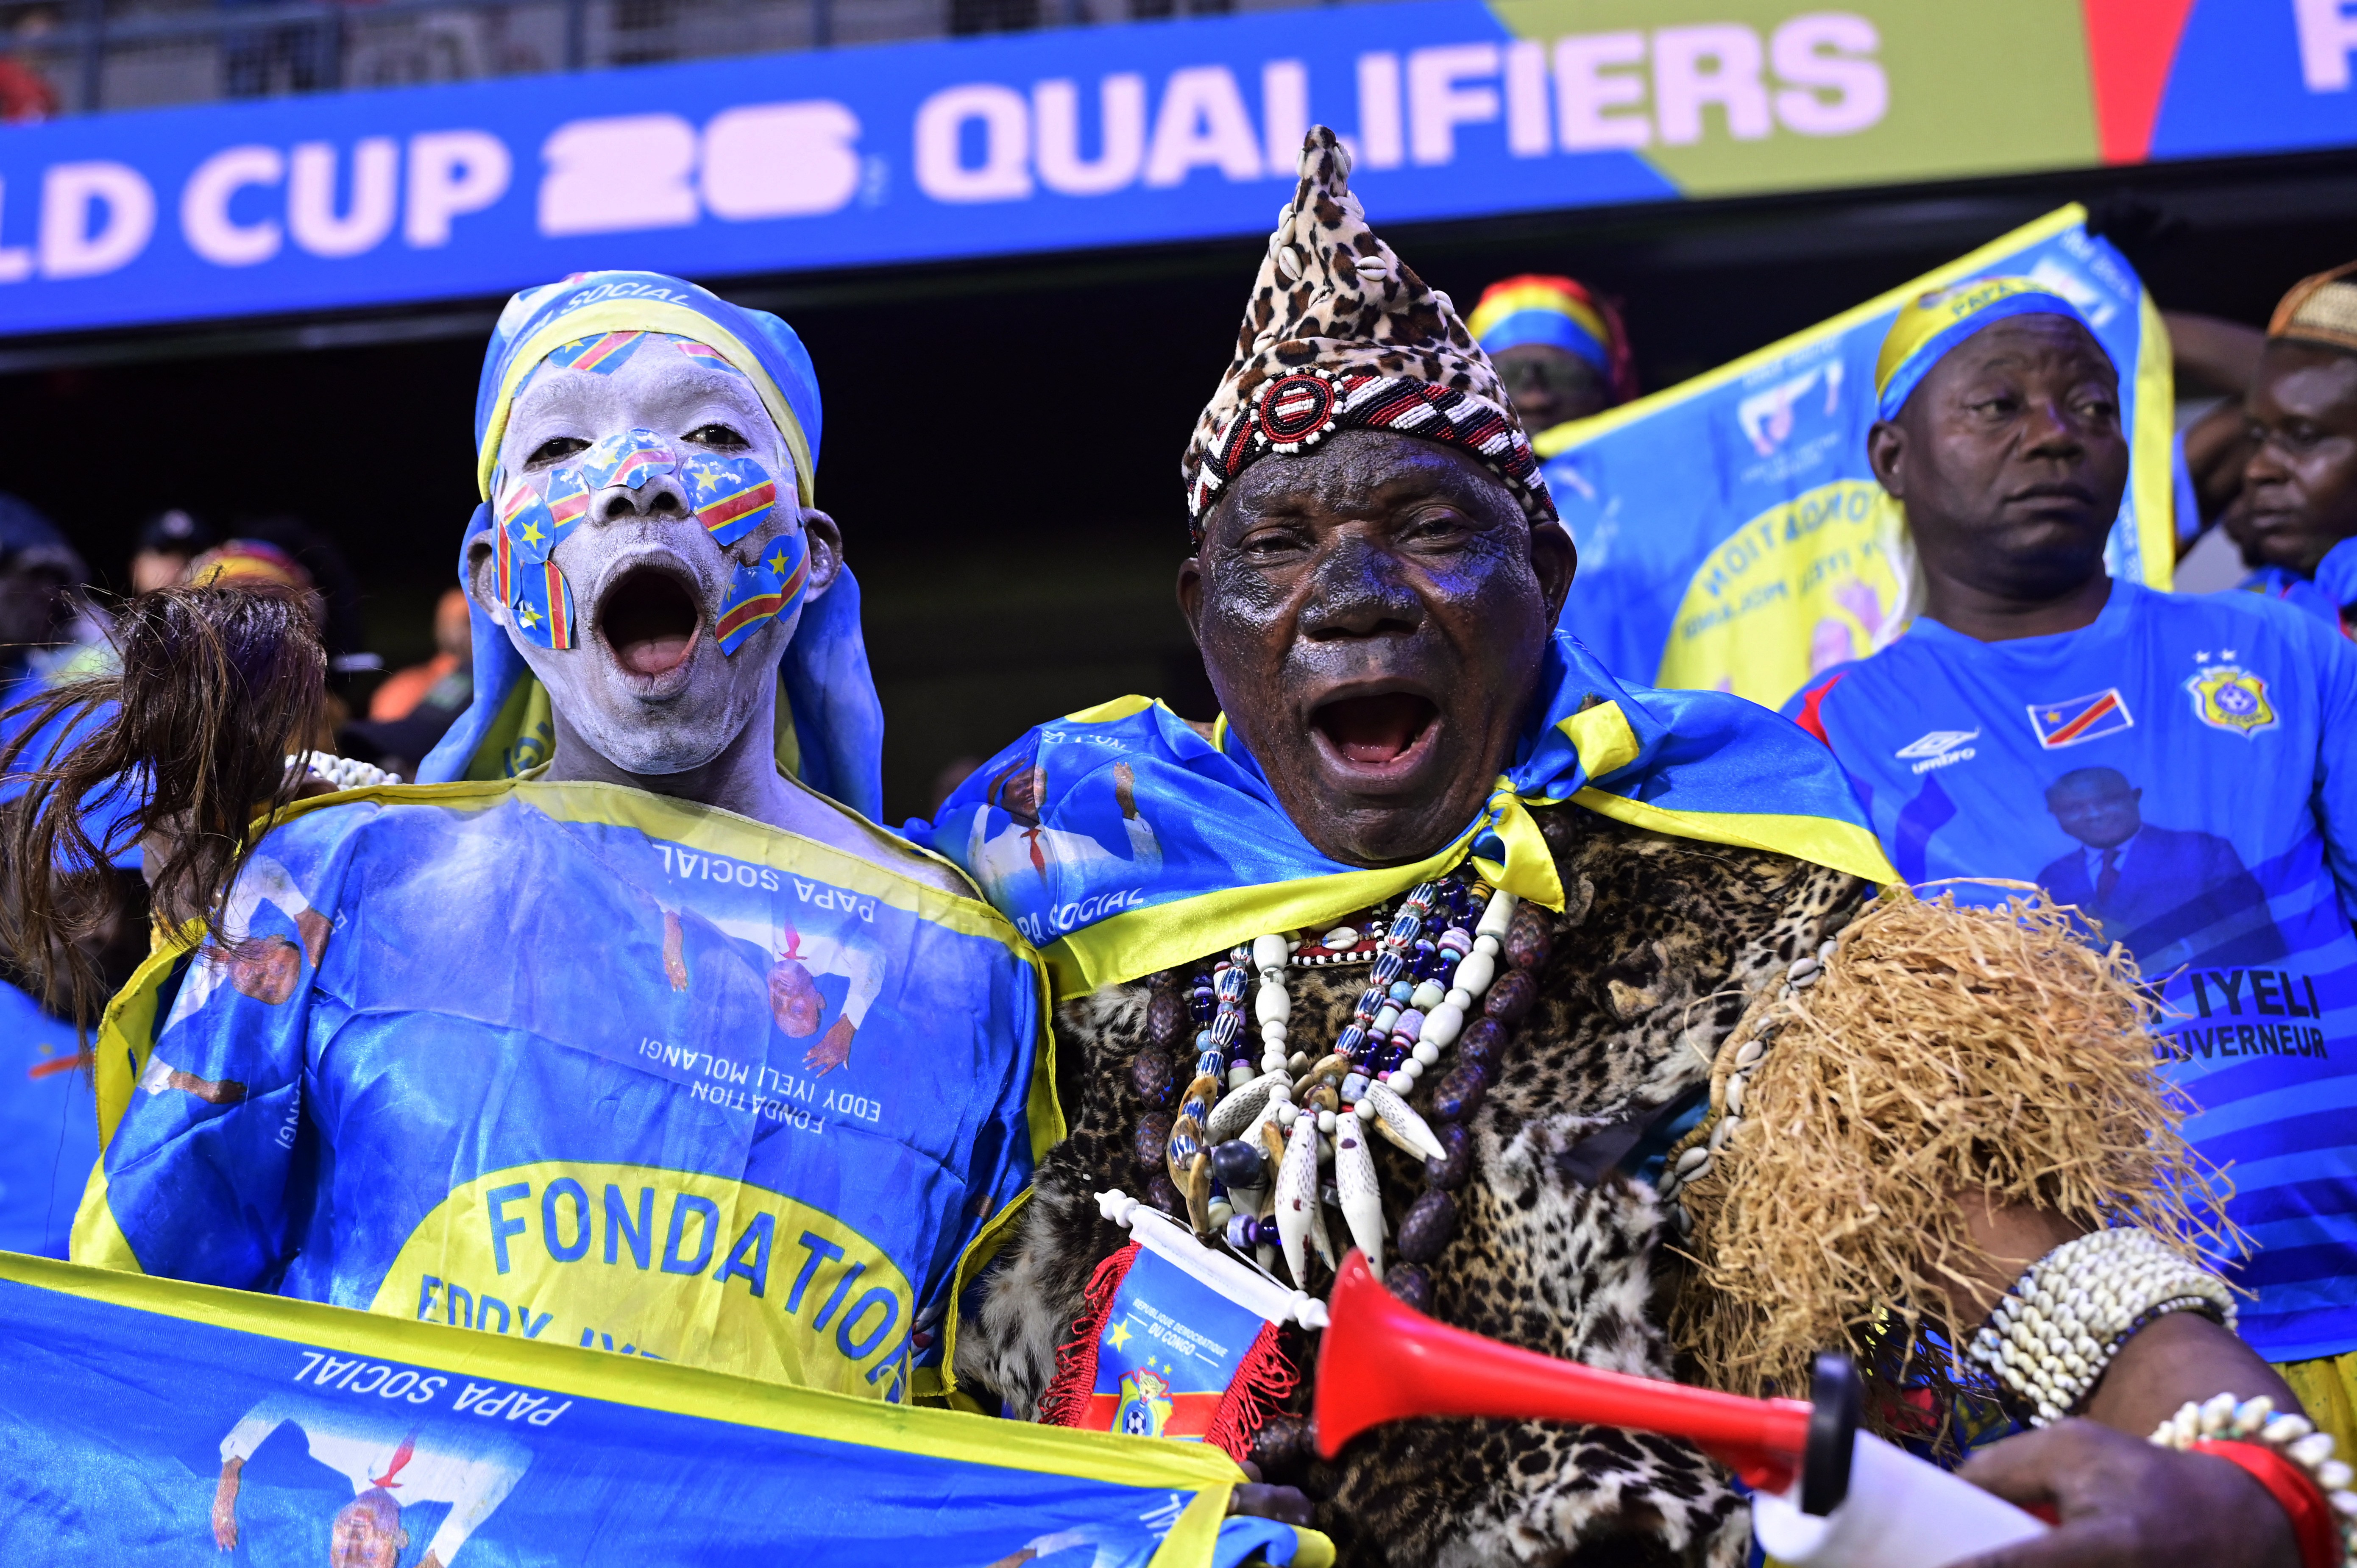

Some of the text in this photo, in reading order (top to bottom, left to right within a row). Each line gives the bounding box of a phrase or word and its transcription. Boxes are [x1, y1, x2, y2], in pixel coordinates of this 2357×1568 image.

[180, 129, 513, 268] CUP
[537, 98, 863, 237] 26
[913, 11, 1888, 204] QUALIFIERS
[560, 282, 689, 315] SOCIAL
[1911, 747, 1976, 775] umbro
[652, 843, 876, 923] PAPA SOCIAL
[1048, 887, 1144, 936] SOCIAL
[2190, 969, 2321, 1019] IYELI
[638, 1037, 881, 1123] EDDY IYELI MOLANGI
[691, 1080, 826, 1135] FONDATION
[1132, 1298, 1229, 1358] REPUBLIQUE DEMOCRATIQUE
[1148, 1322, 1196, 1356] DU CONGO
[294, 1351, 573, 1426] PAPA SOCIAL
